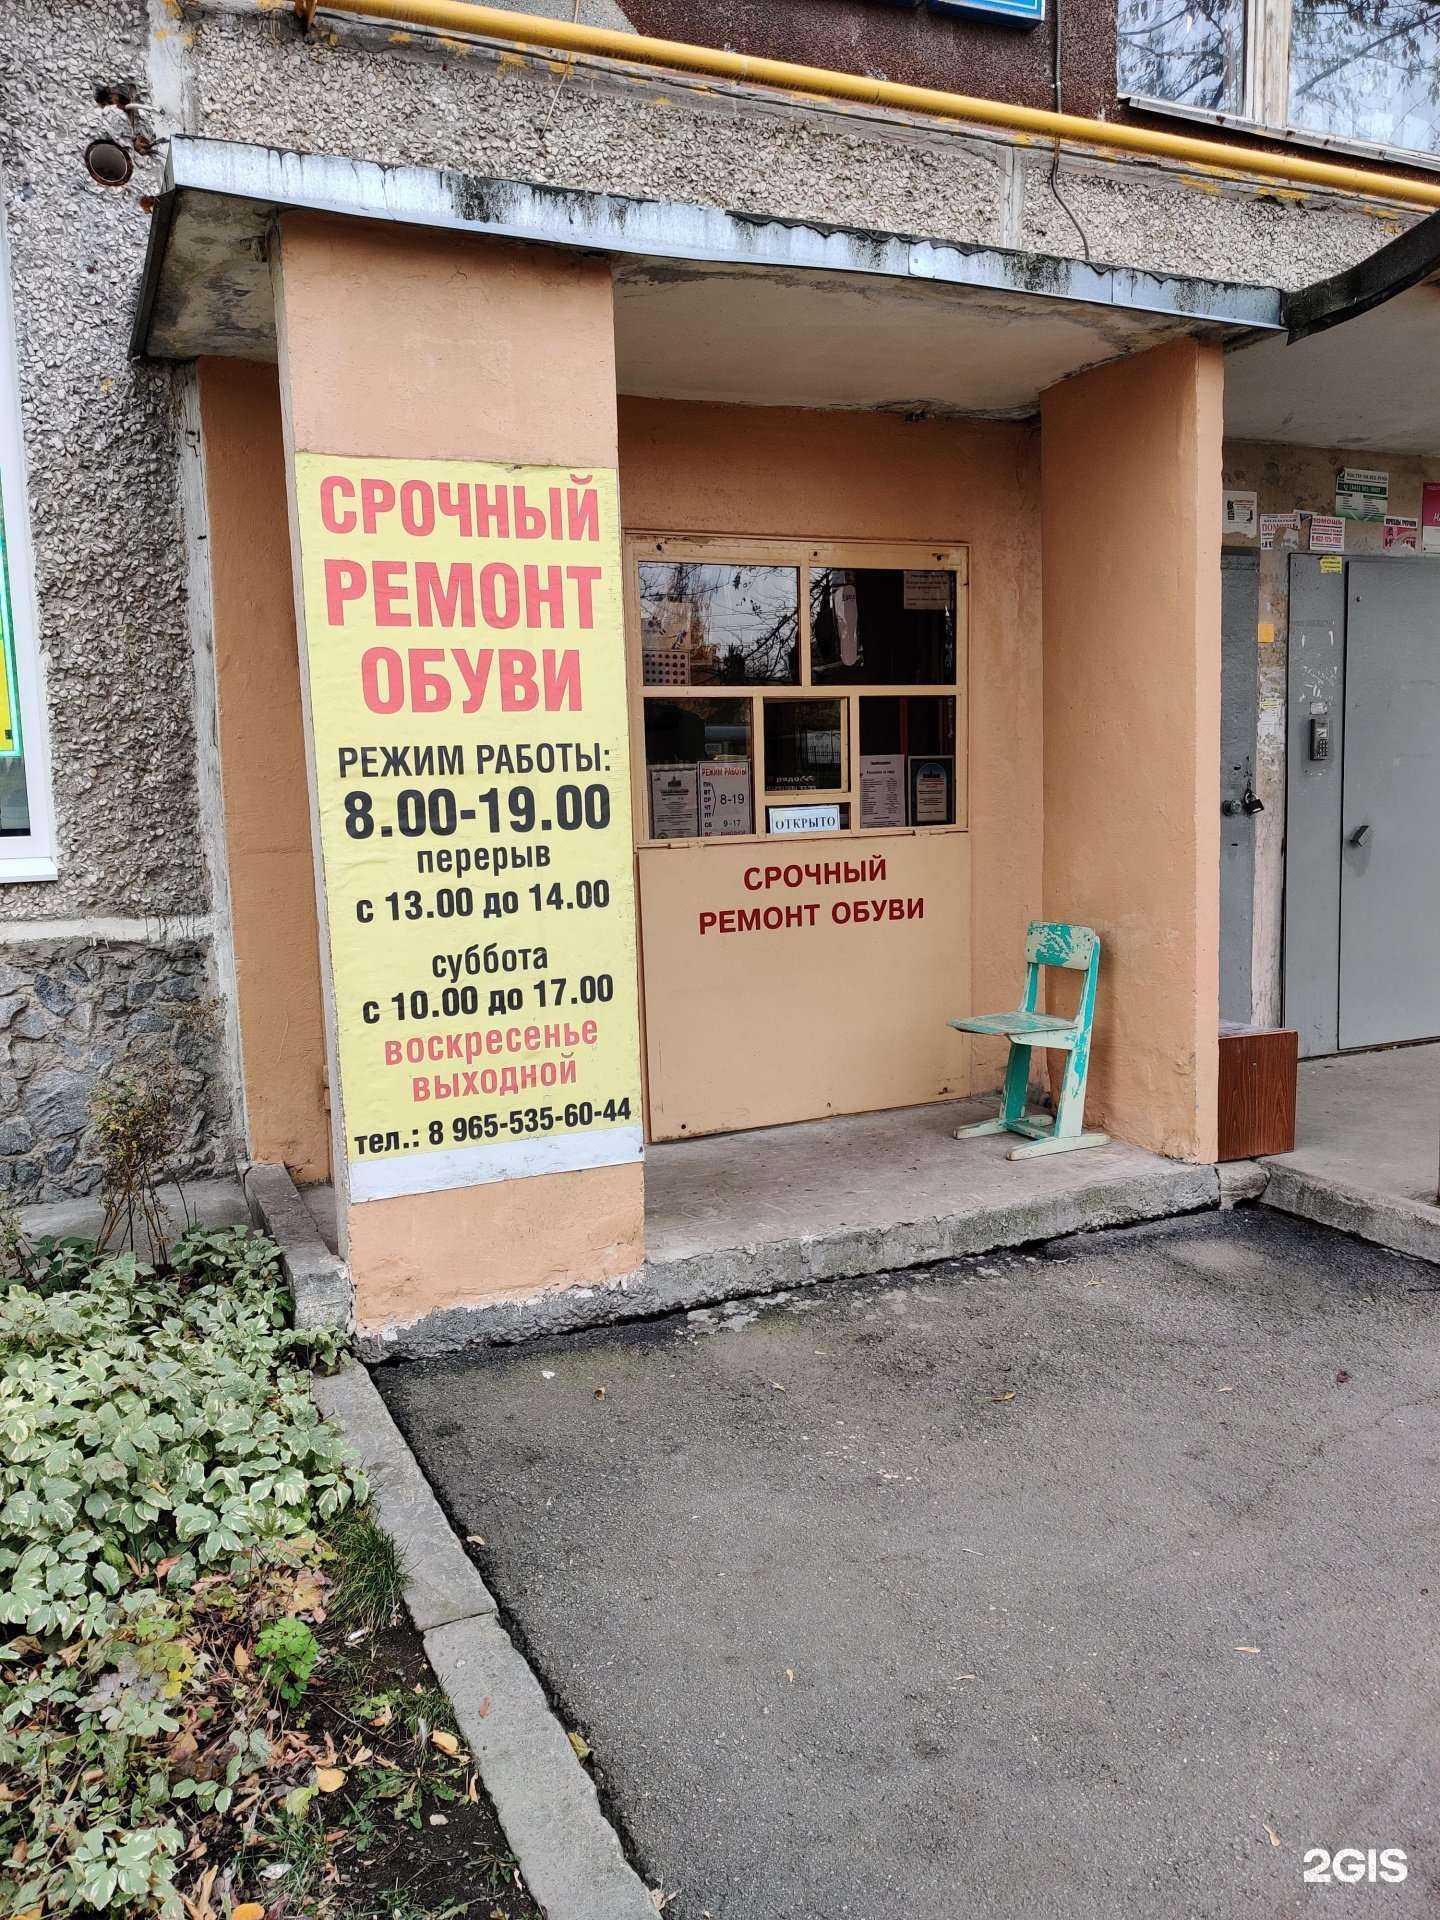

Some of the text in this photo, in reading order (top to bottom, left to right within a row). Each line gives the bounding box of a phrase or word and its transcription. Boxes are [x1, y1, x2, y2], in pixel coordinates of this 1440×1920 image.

[320, 474, 599, 541] СРОЧНЫЙ
[324, 559, 601, 629] РЕМОНТ
[362, 647, 582, 714] ОБУВИ
[339, 743, 610, 778] РЕЖИМ РАБОТЫ:
[702, 768, 746, 776] РЕЖИМ РАБОТЫ
[345, 784, 610, 839] 8.00-19.00
[720, 794, 744, 805] 8-19
[776, 816, 836, 830] ОТКРЫТО
[418, 846, 550, 878] перерыв
[744, 855, 885, 890] СРОЧНЫЙ
[357, 880, 609, 923] с 13.00 до 14.00
[700, 898, 923, 934] РЕМОНТ ОБУВИ
[432, 943, 548, 983] суббота
[363, 974, 613, 1024] с 10.00 до 17.00
[385, 1020, 598, 1065] воскресенье
[413, 1052, 576, 1102] выходной
[354, 1098, 631, 1154] тел.: 8 965-535-60-44
